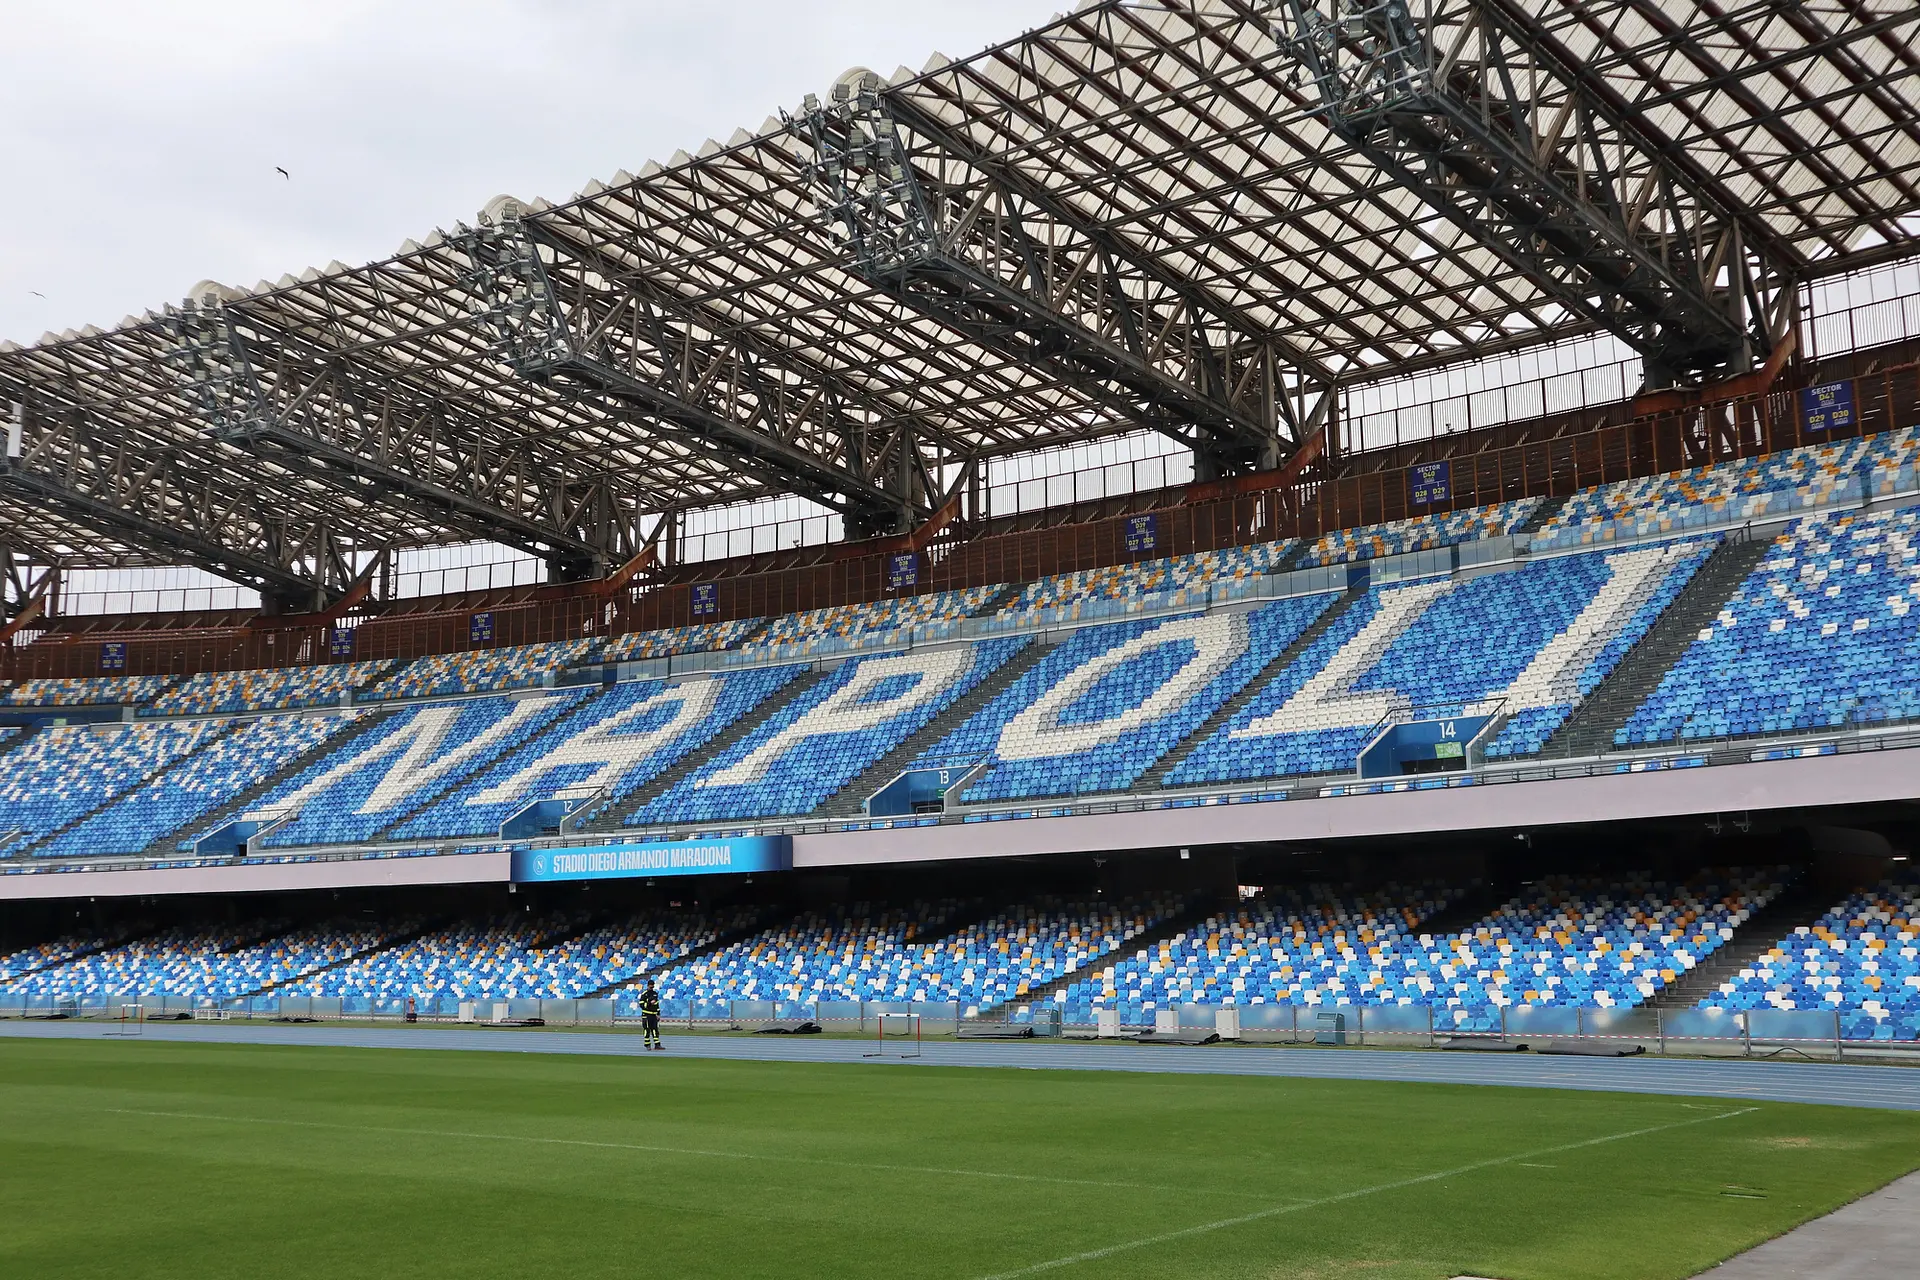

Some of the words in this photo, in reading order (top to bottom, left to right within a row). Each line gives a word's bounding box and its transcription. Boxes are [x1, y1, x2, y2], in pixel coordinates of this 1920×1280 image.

[1812, 384, 1842, 396] SECTOR
[1809, 414, 1825, 423] D29
[1832, 410, 1849, 419] D30
[1417, 464, 1440, 473] SECTOR
[1415, 490, 1428, 498] D28
[1433, 487, 1445, 495] D29
[1131, 516, 1150, 524] SECTOR
[240, 542, 1717, 820] NAPOLI
[1439, 722, 1456, 738] 14
[939, 770, 949, 784] 13
[564, 801, 573, 813] 12
[554, 854, 587, 873] STADIO
[588, 851, 617, 872] DIEGO
[618, 849, 671, 871] ARMANDO
[671, 846, 731, 868] MARADONA
